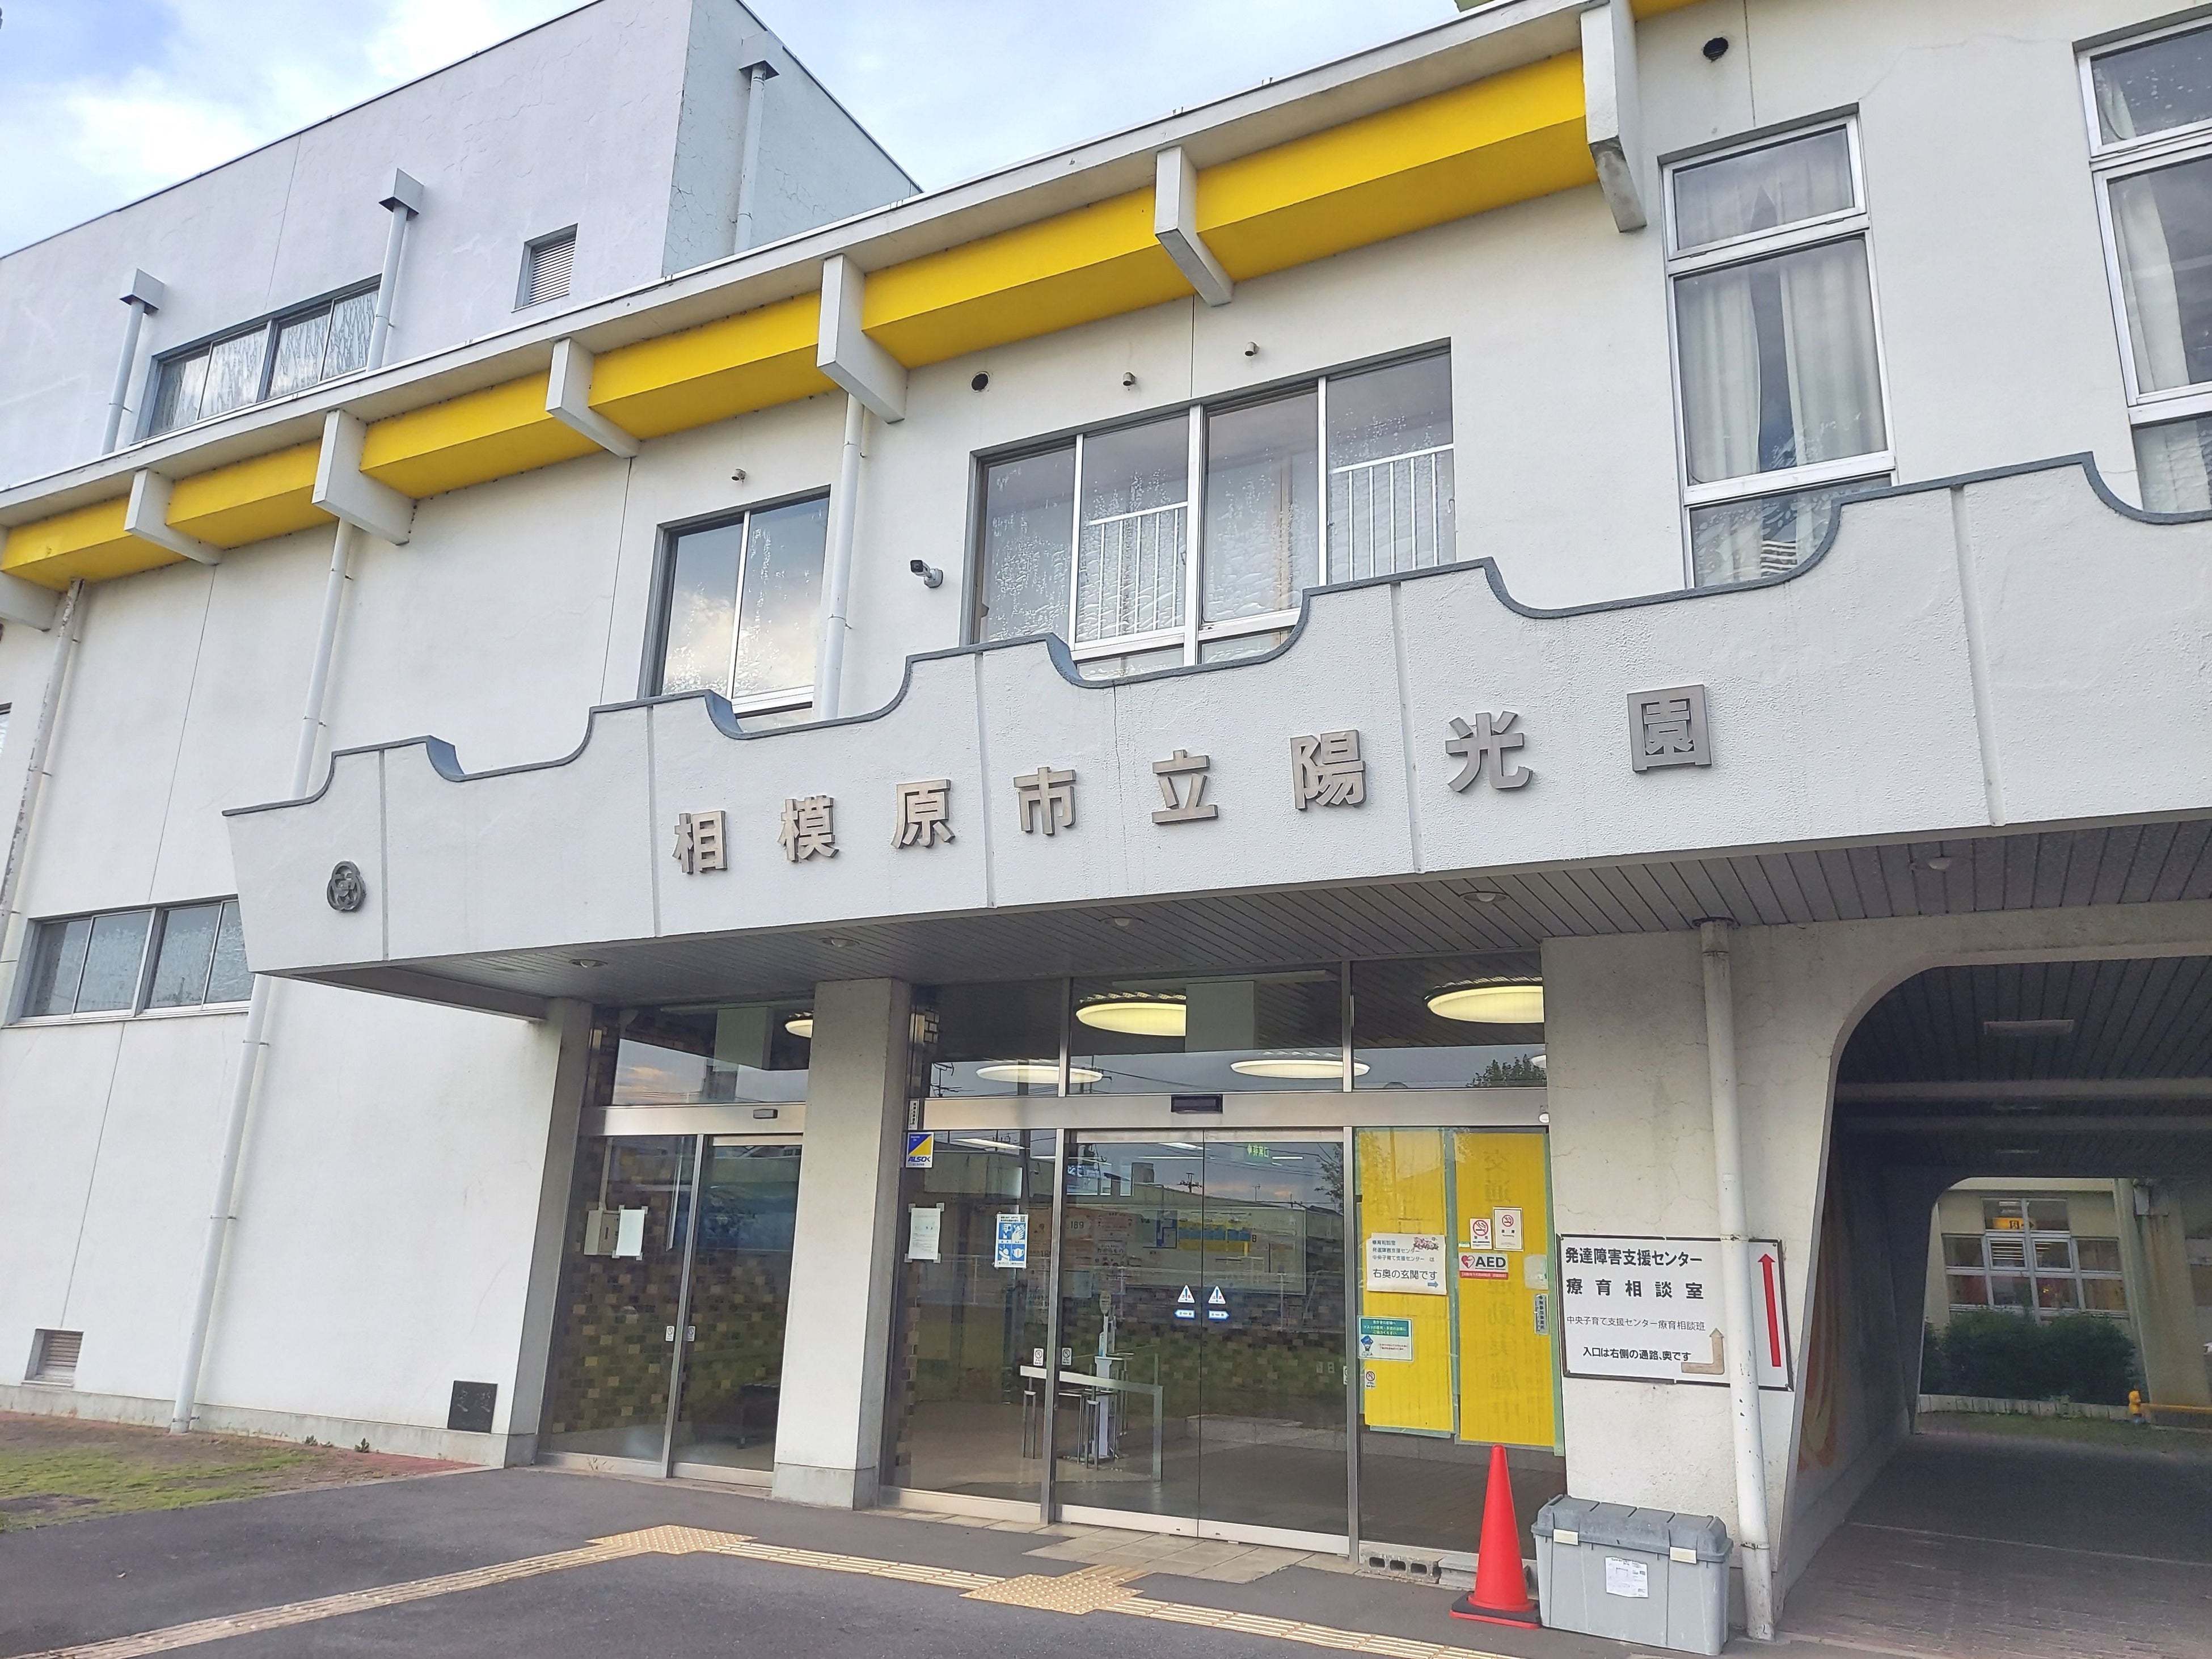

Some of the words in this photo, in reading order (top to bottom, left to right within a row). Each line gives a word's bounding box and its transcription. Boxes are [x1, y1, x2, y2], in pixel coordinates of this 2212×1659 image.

[673, 684, 1712, 875] 相模原市立陽光園
[1070, 1221, 1084, 1230] 189
[1475, 1256, 1506, 1268] AED
[1565, 1247, 1703, 1267] 発達障害支援センター
[1373, 1268, 1438, 1281] 右奥の玄関です
[1566, 1278, 1704, 1299] 療育相談室
[1567, 1316, 1706, 1331] 中央子育て支援センター療育相談班
[1583, 1346, 1691, 1362] 入口は右側の通路、奥です
